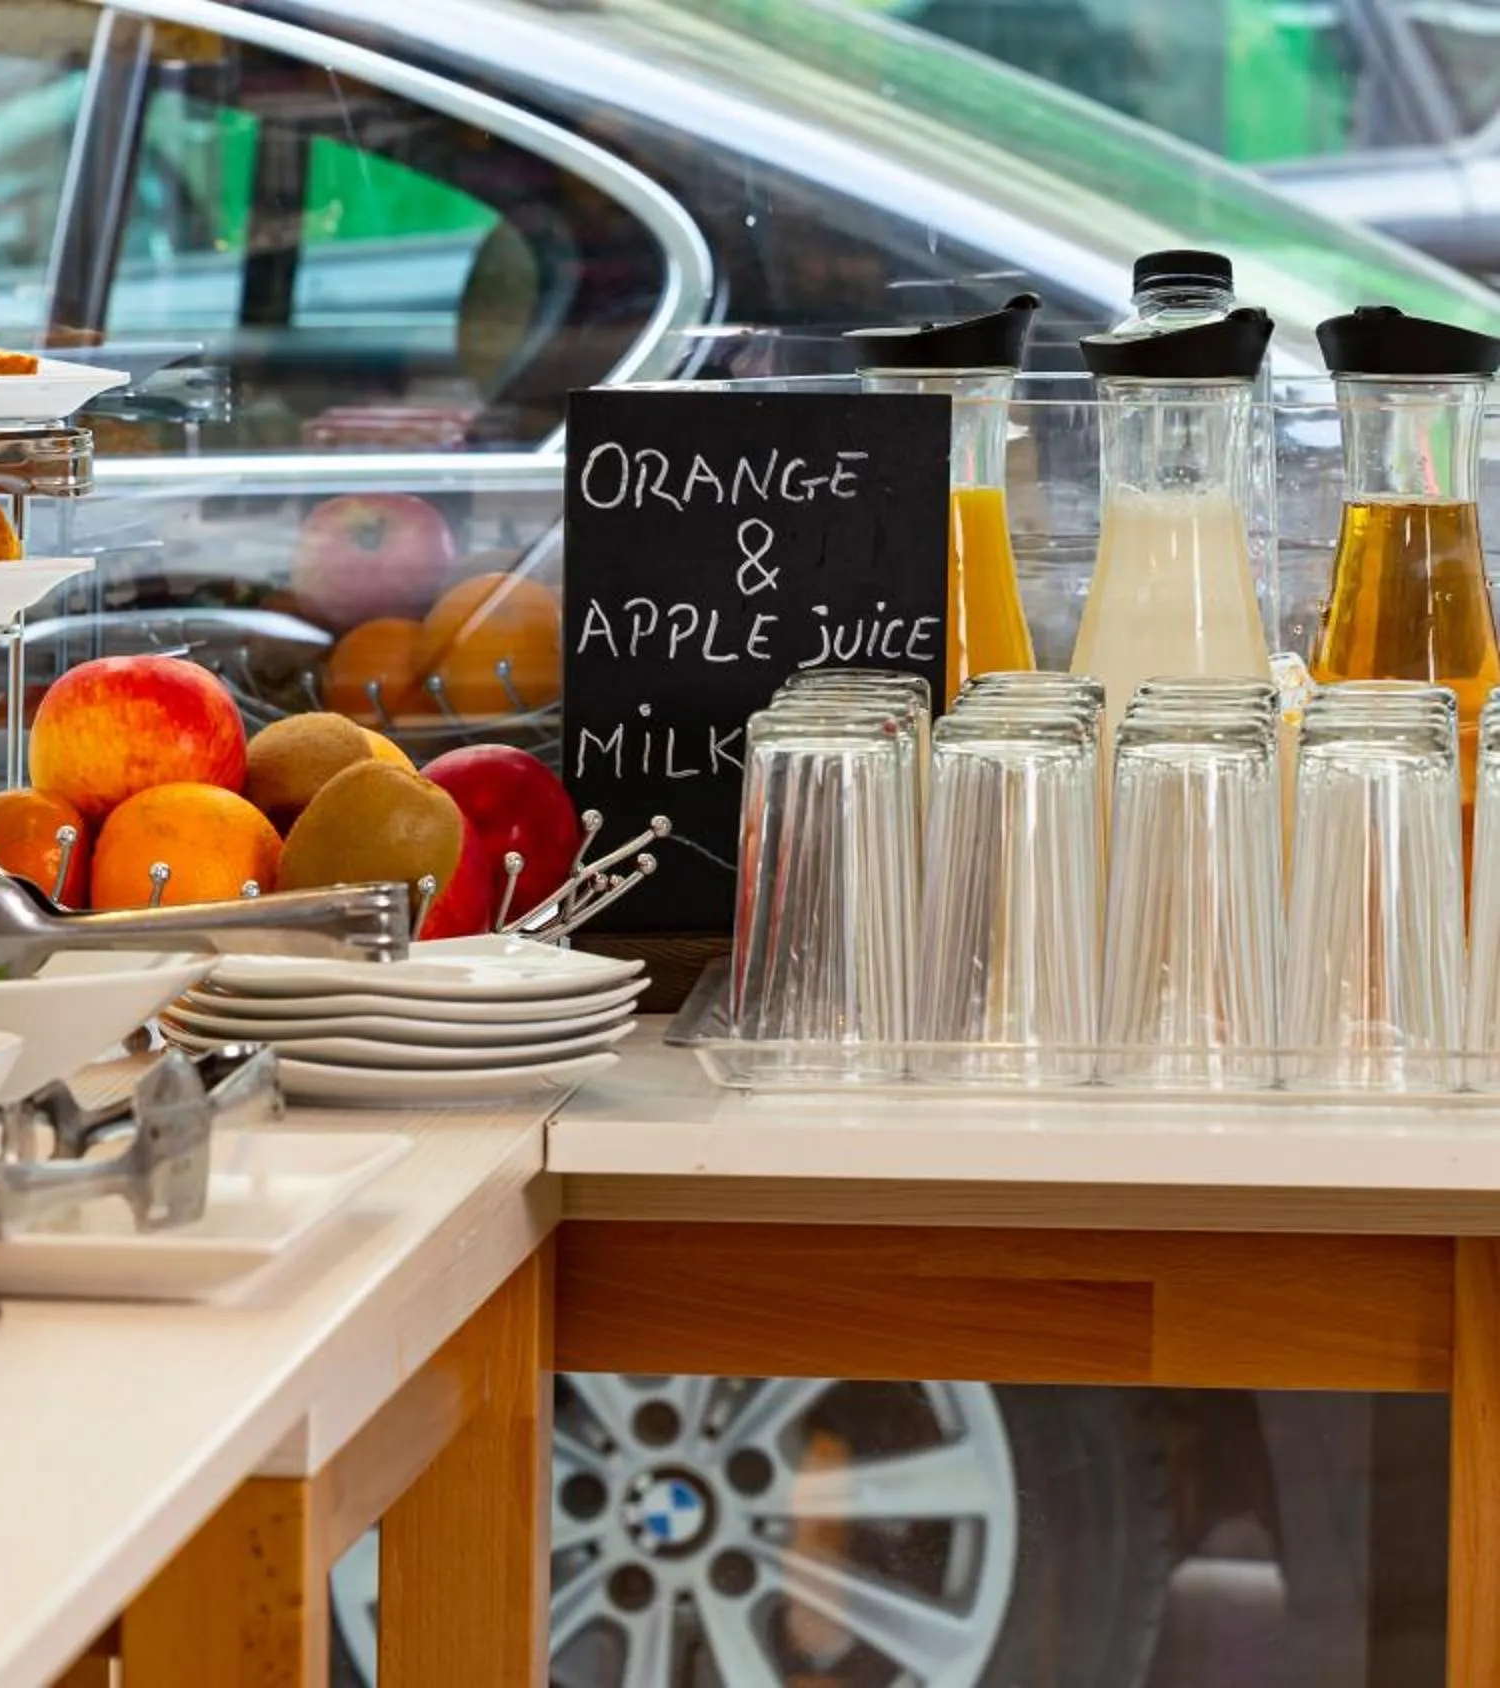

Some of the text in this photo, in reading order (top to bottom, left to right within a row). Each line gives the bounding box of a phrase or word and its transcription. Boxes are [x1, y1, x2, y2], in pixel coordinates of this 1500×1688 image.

[580, 442, 869, 512] ORANGE
[736, 517, 781, 596] &
[576, 598, 780, 663] APPLE
